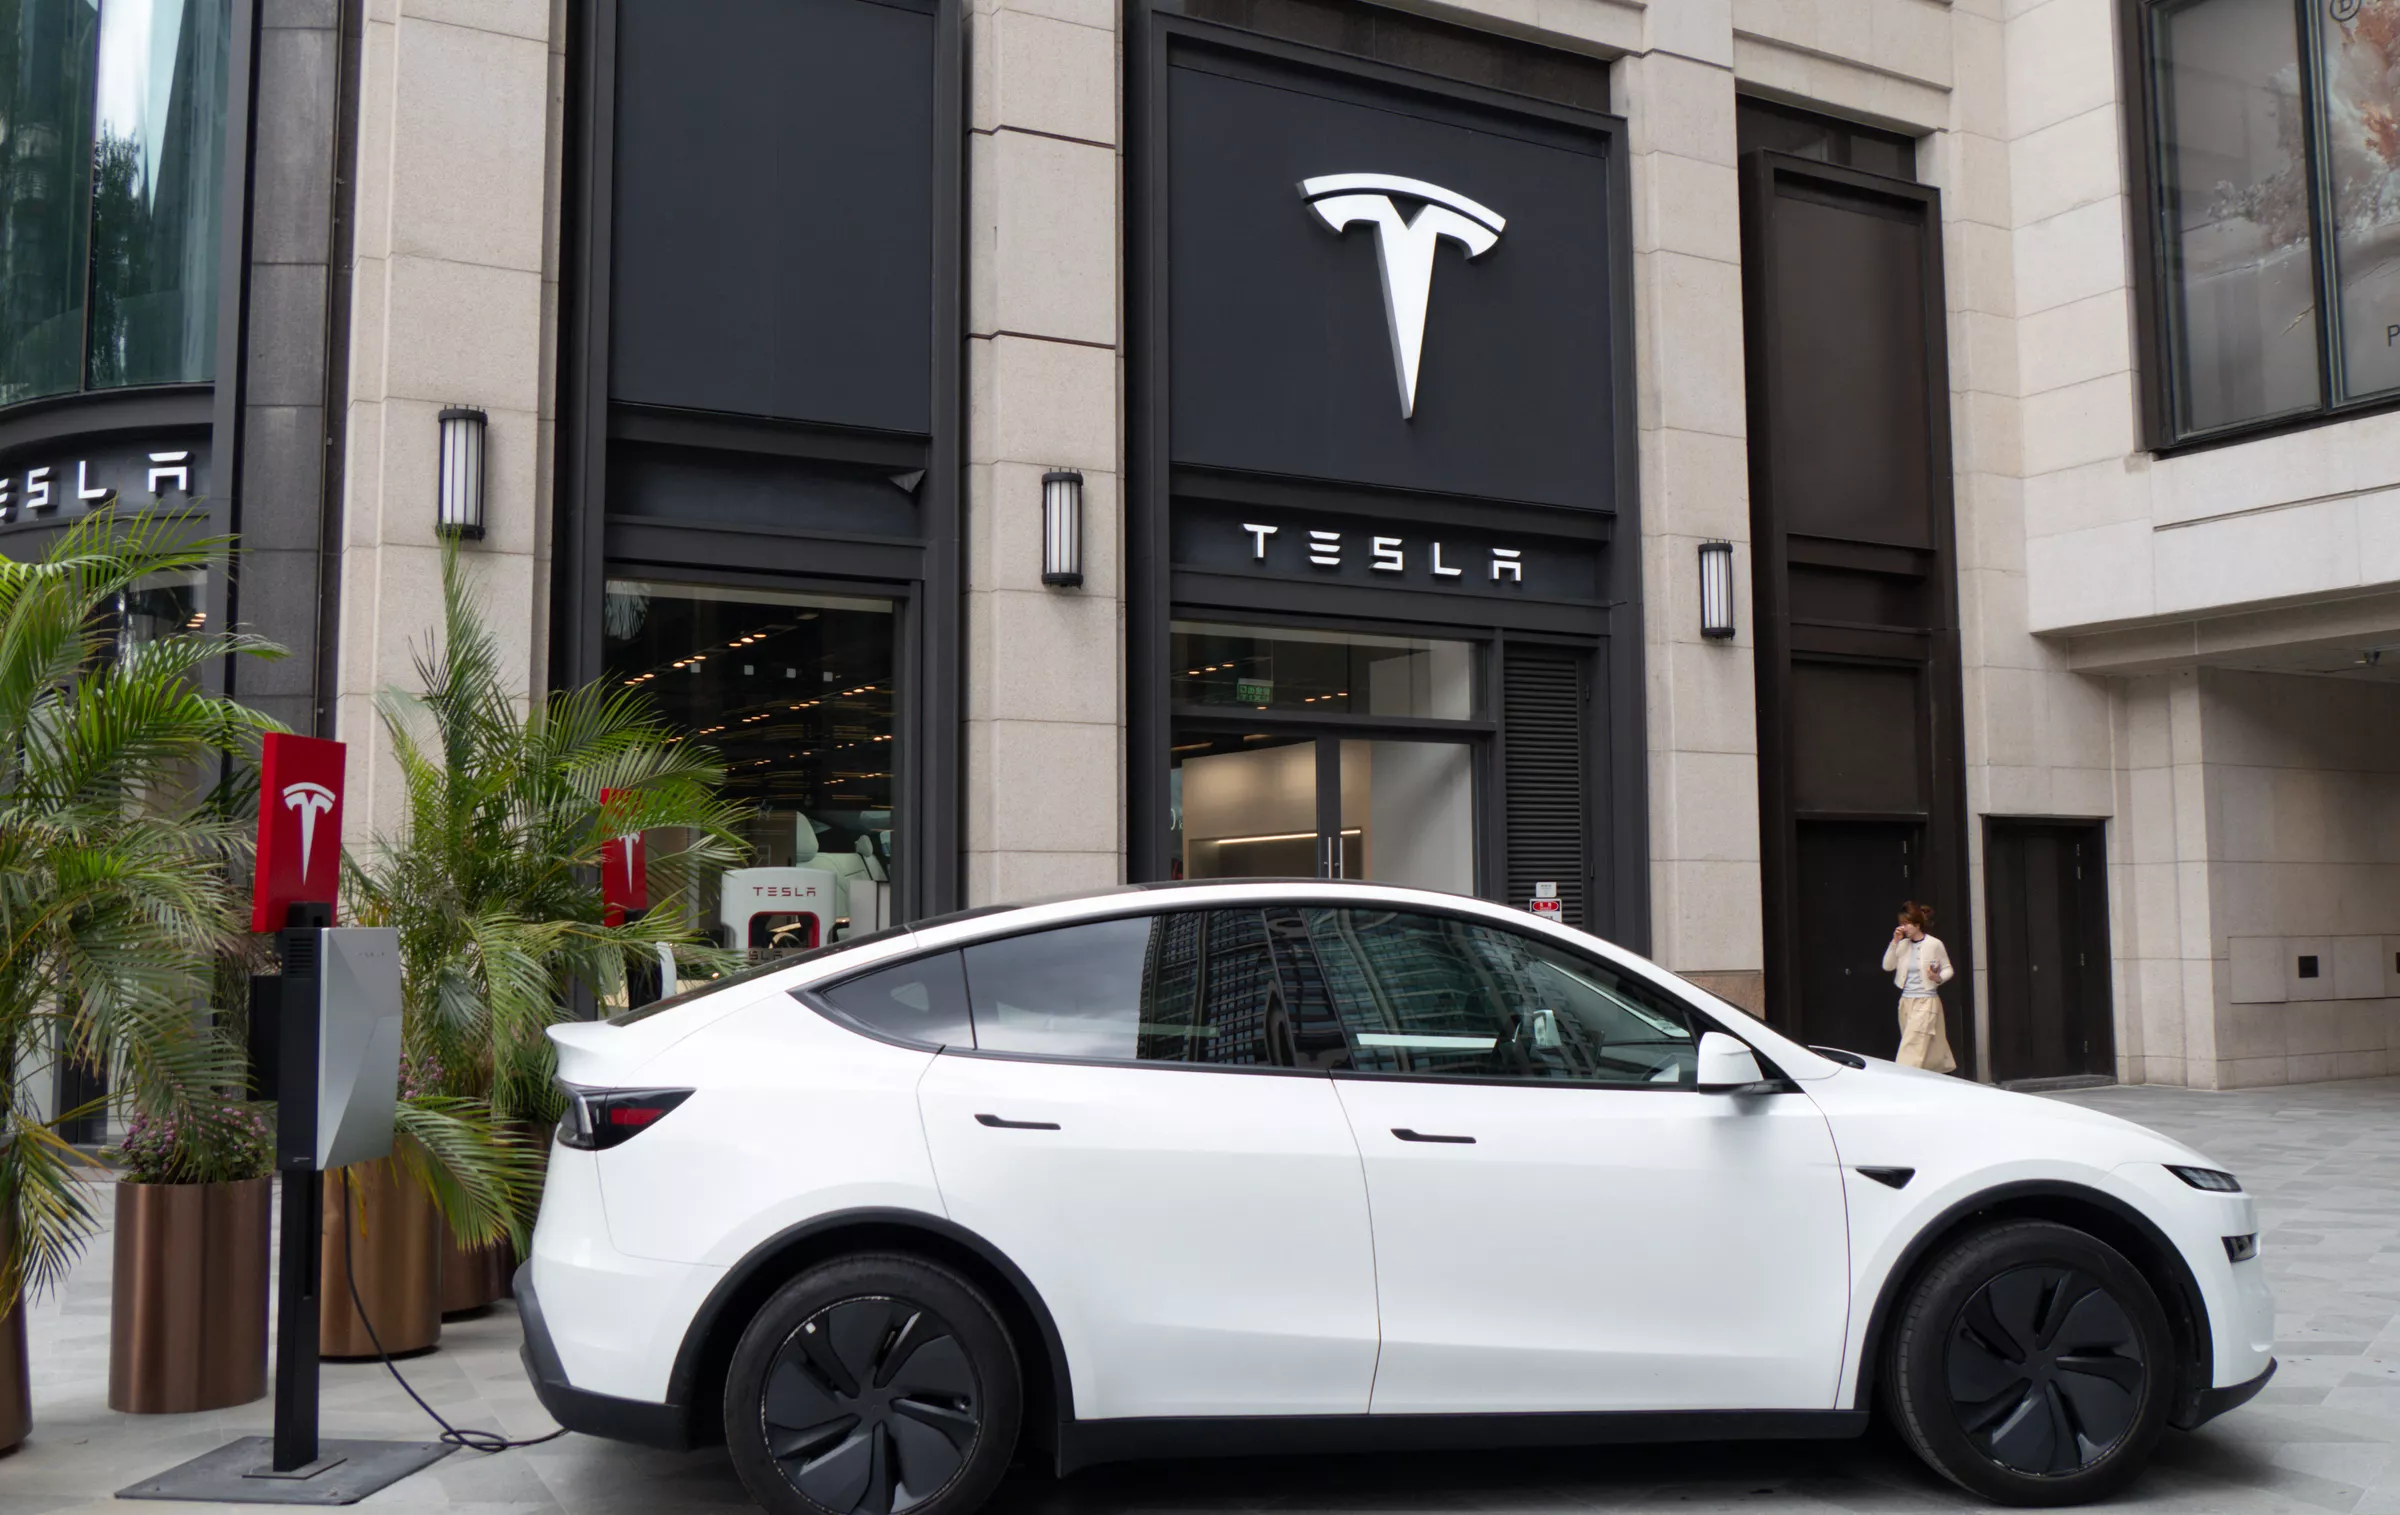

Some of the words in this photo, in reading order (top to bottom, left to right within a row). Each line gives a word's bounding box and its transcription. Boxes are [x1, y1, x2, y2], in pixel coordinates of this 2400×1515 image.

[1241, 522, 1523, 583] TESLA
[752, 886, 817, 897] TESLA
[748, 950, 783, 961] SLA
